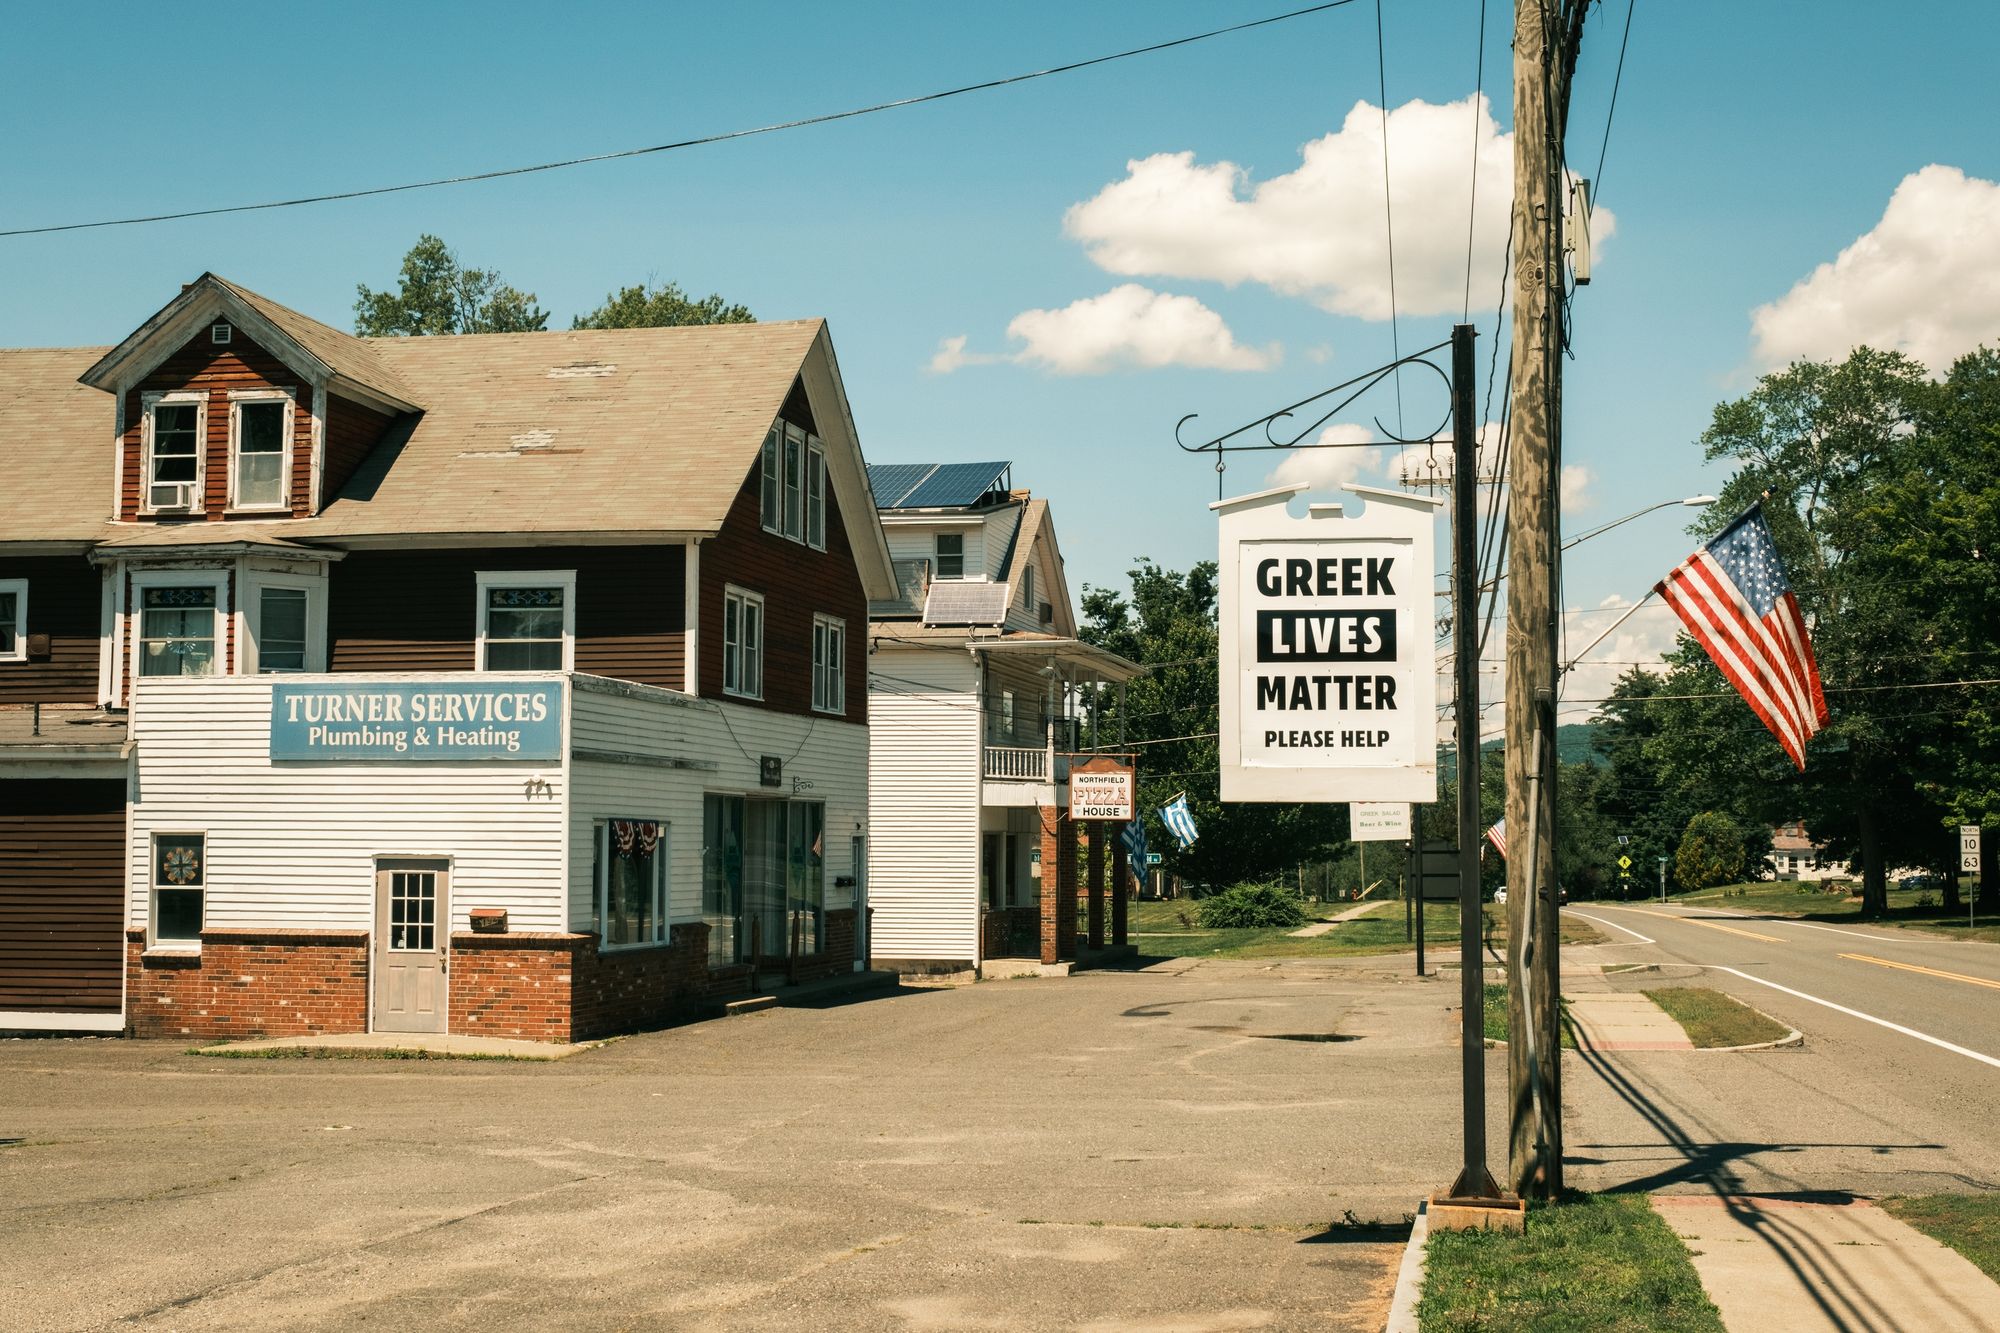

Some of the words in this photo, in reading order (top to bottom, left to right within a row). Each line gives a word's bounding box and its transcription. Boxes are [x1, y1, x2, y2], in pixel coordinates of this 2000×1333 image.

[1256, 557, 1396, 597] GREEK
[1272, 617, 1382, 654] LIVES
[1257, 675, 1398, 711] MATTER
[285, 694, 404, 723] TURNER
[411, 693, 547, 722] SERVICES
[308, 726, 408, 752] Plumbing
[413, 727, 430, 746] &
[437, 725, 521, 752] Heating
[1265, 730, 1335, 748] PLEASE
[1341, 730, 1390, 748] HELP
[1073, 787, 1129, 805] PIZZA
[1083, 807, 1120, 816] HOUSE
[1964, 839, 1976, 849] 10
[1963, 857, 1978, 868] 63
